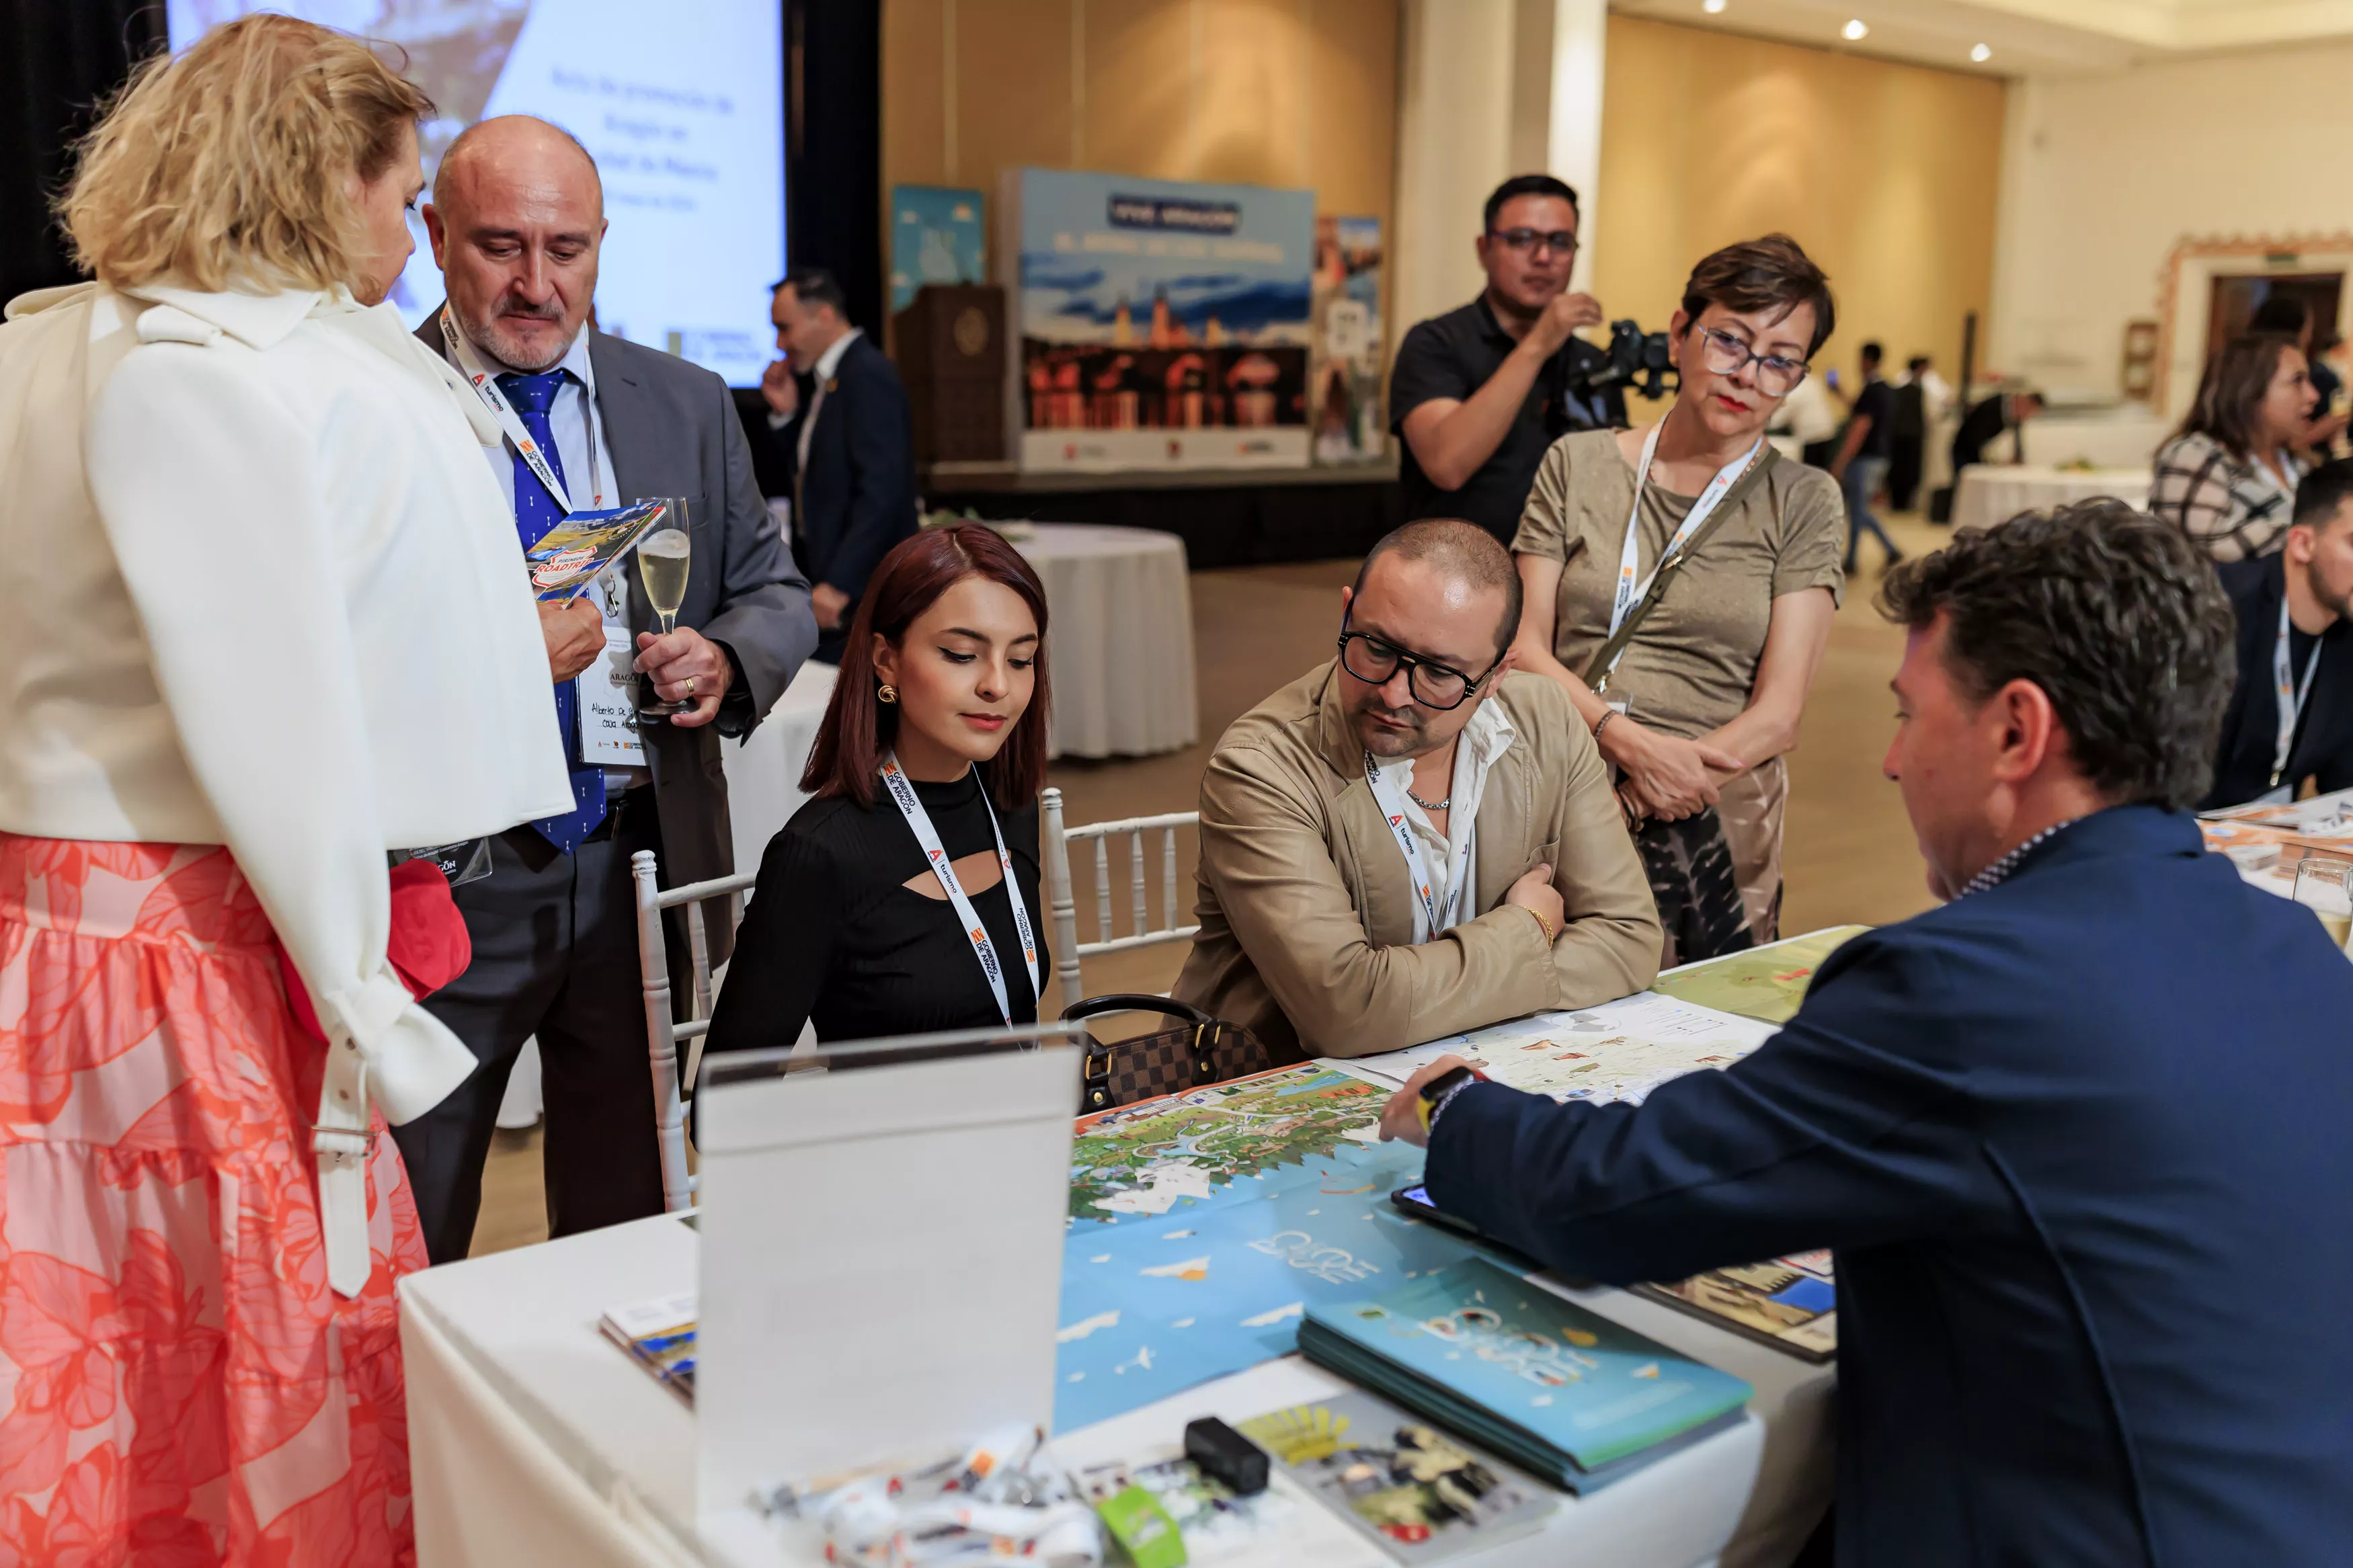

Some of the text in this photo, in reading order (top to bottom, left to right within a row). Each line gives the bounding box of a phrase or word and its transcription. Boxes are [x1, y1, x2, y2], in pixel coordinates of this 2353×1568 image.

[485, 386, 504, 411] turismo
[526, 452, 553, 487] DE ARAGON
[532, 450, 553, 481] GOBIERNO
[536, 559, 593, 573] ROADTRIP
[592, 702, 614, 714] Alberto
[1367, 750, 1380, 776] OBIERNO
[887, 774, 913, 815] DE ARAGON
[893, 772, 916, 807] GOBIERNO
[1400, 827, 1414, 854] turismo
[941, 864, 957, 893] turismo
[1017, 913, 1029, 950] GOBIERNO
[1019, 907, 1033, 949] DE ARAGON
[976, 942, 996, 983] DE ARAGON
[982, 940, 998, 975] GOBIERNO
